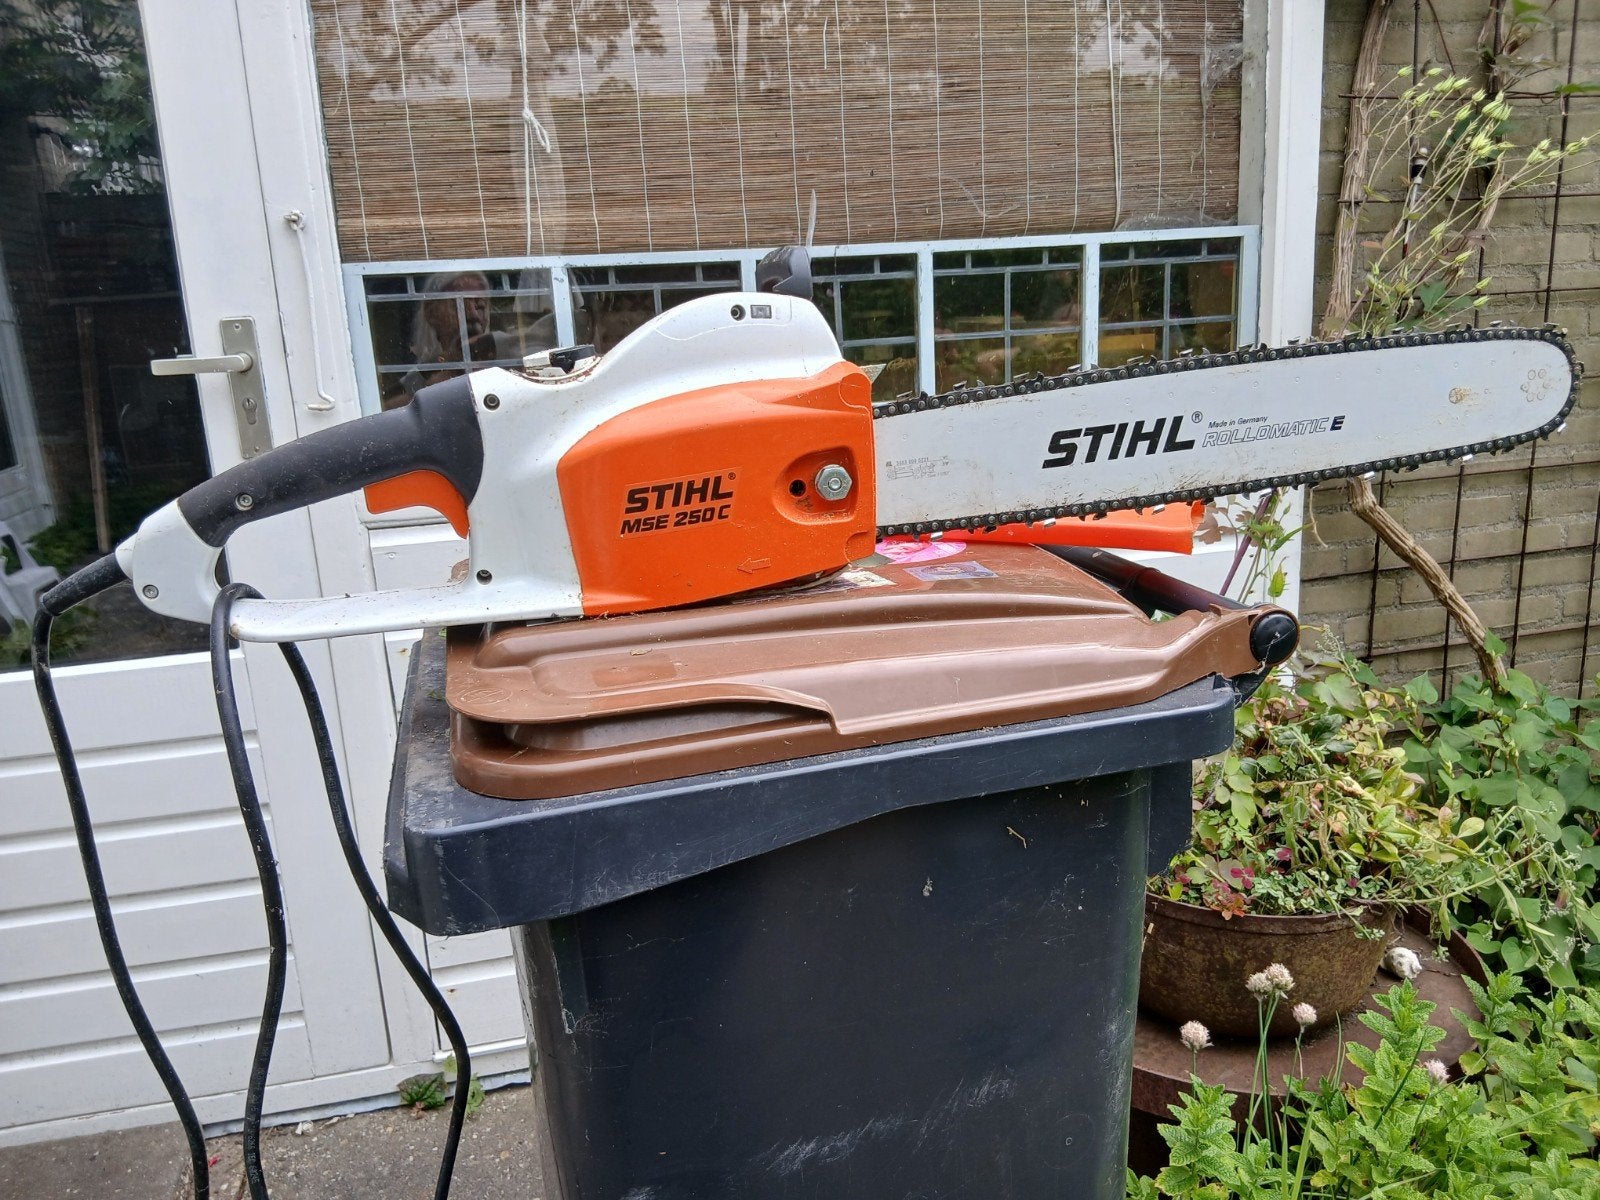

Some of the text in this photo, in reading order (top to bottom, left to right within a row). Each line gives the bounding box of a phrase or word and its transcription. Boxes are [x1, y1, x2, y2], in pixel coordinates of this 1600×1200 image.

[1202, 415, 1346, 447] ROLLOMATIC E
[1208, 415, 1268, 429] Made in Germany
[1042, 415, 1196, 469] STIHL
[624, 475, 734, 514] STIHL
[620, 504, 731, 534] MSE 250 C
